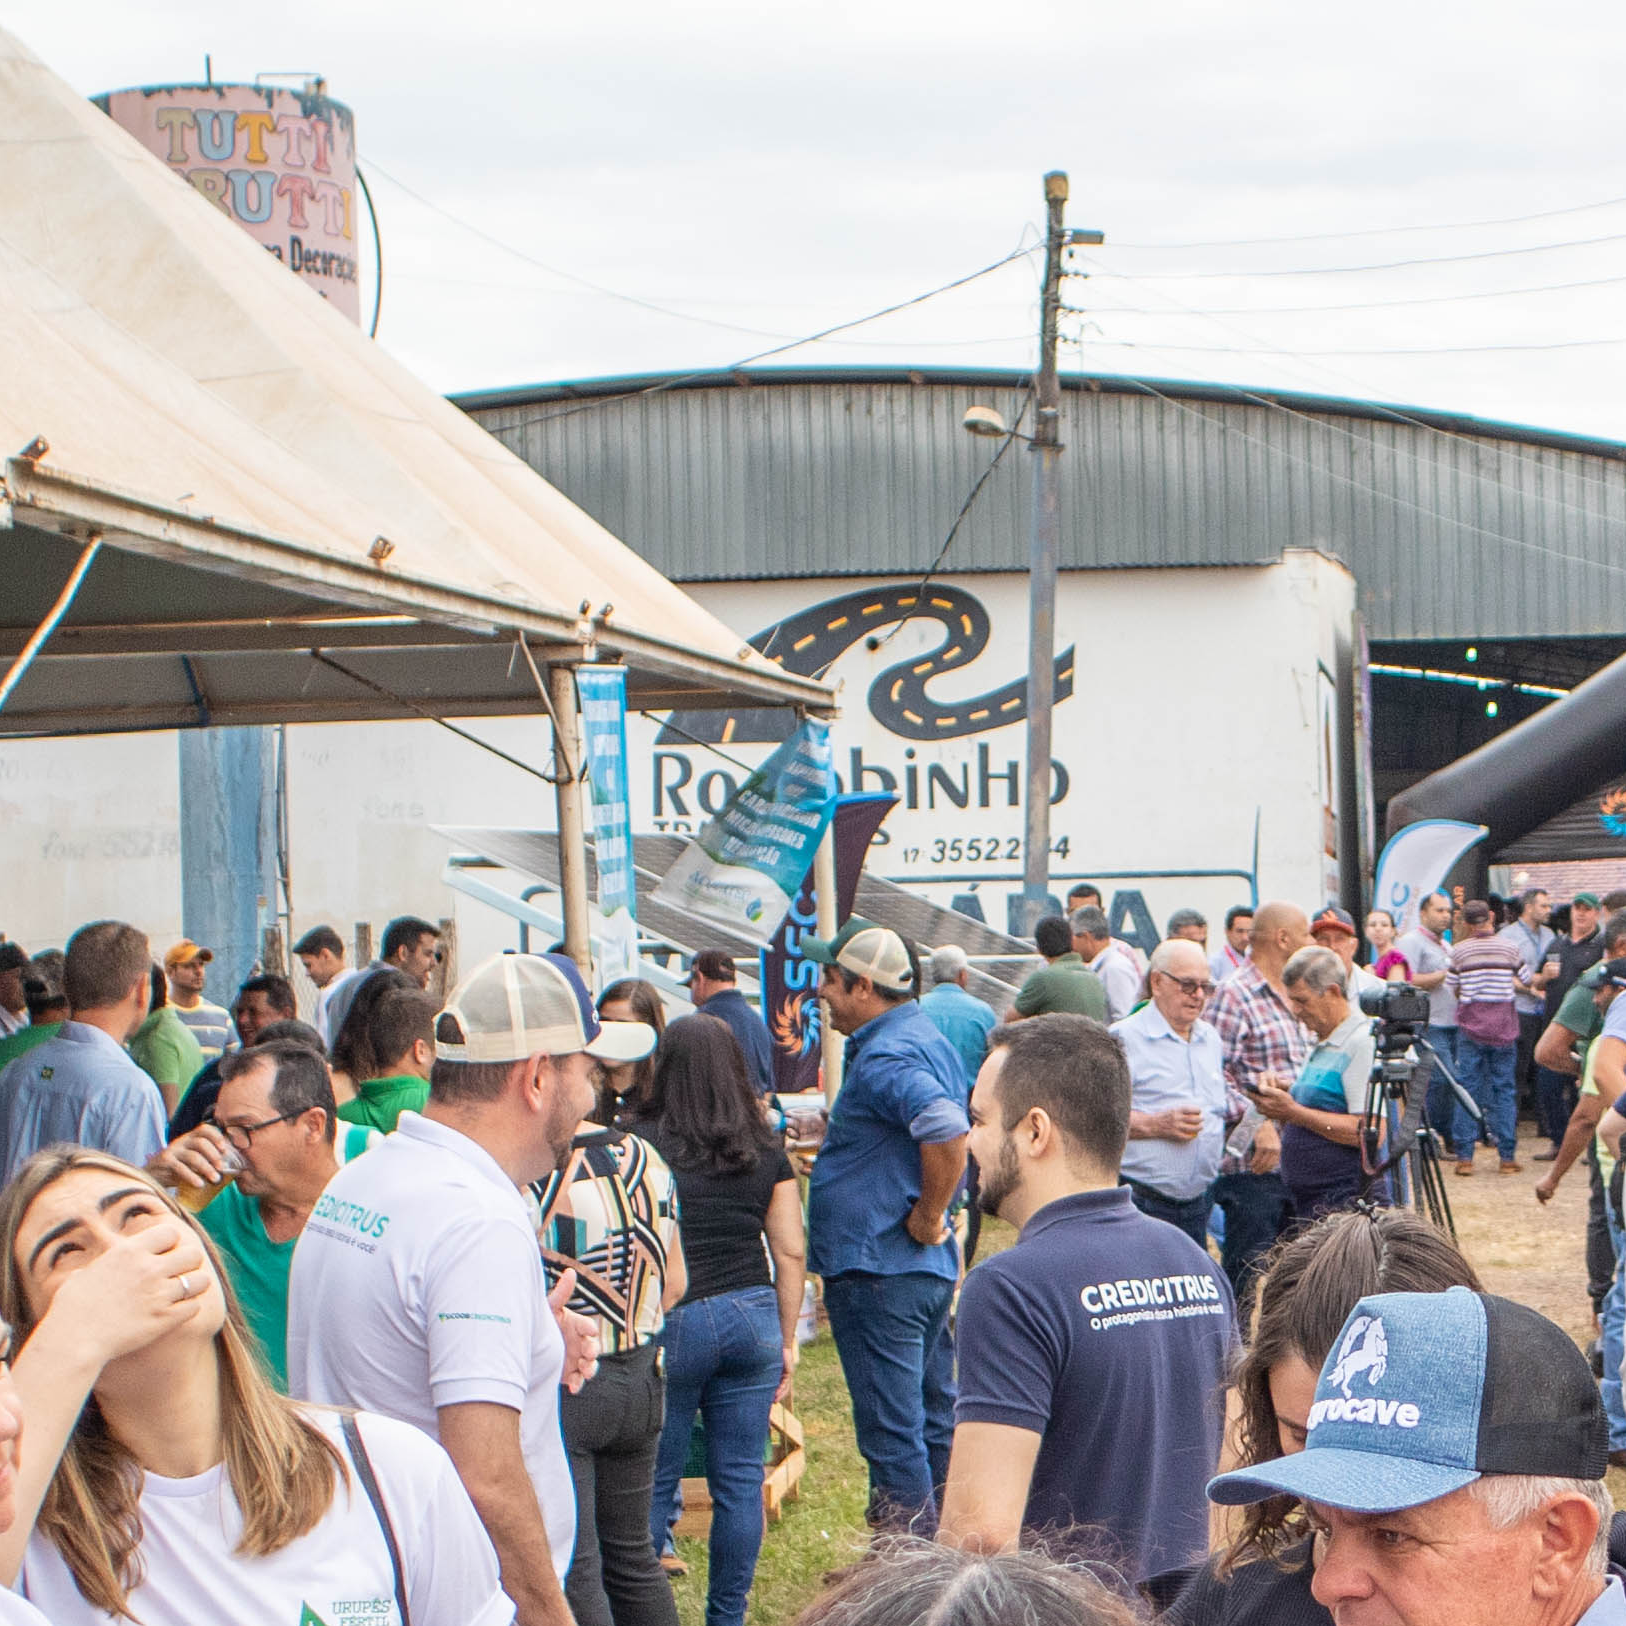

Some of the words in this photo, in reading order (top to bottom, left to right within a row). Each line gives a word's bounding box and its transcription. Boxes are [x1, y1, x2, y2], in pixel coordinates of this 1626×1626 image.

[157, 107, 331, 174] TUTTI
[1080, 1274, 1220, 1314] CREDICITRUS
[1090, 1316, 1102, 1332] O
[332, 1597, 392, 1616] URUPÊS
